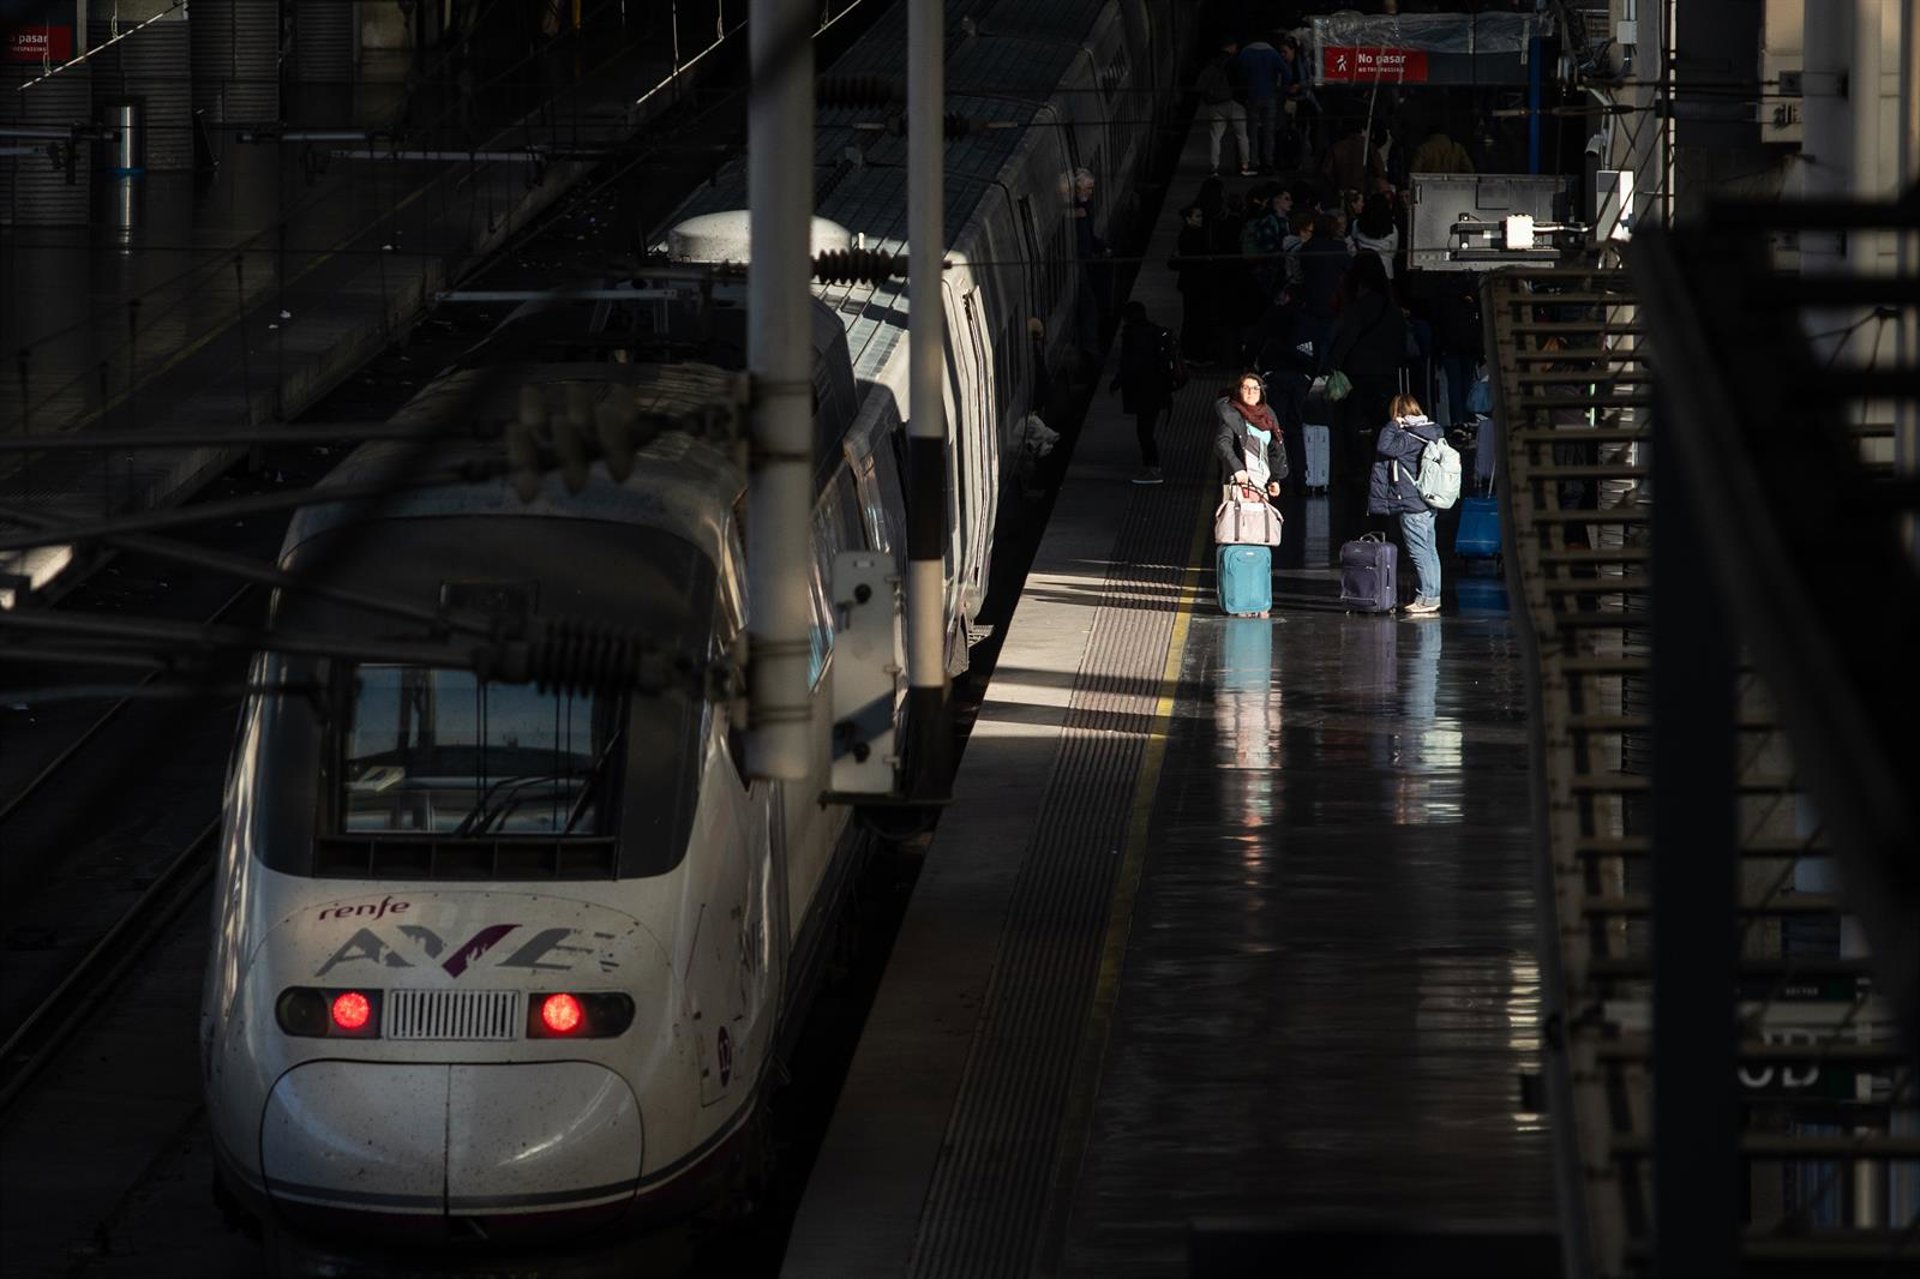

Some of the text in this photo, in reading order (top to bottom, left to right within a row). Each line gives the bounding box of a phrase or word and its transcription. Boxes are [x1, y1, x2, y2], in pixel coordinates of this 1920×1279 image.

[18, 34, 47, 45] pasar
[1358, 53, 1407, 66] No pasar
[318, 895, 411, 921] renfe
[314, 923, 619, 978] AVE
